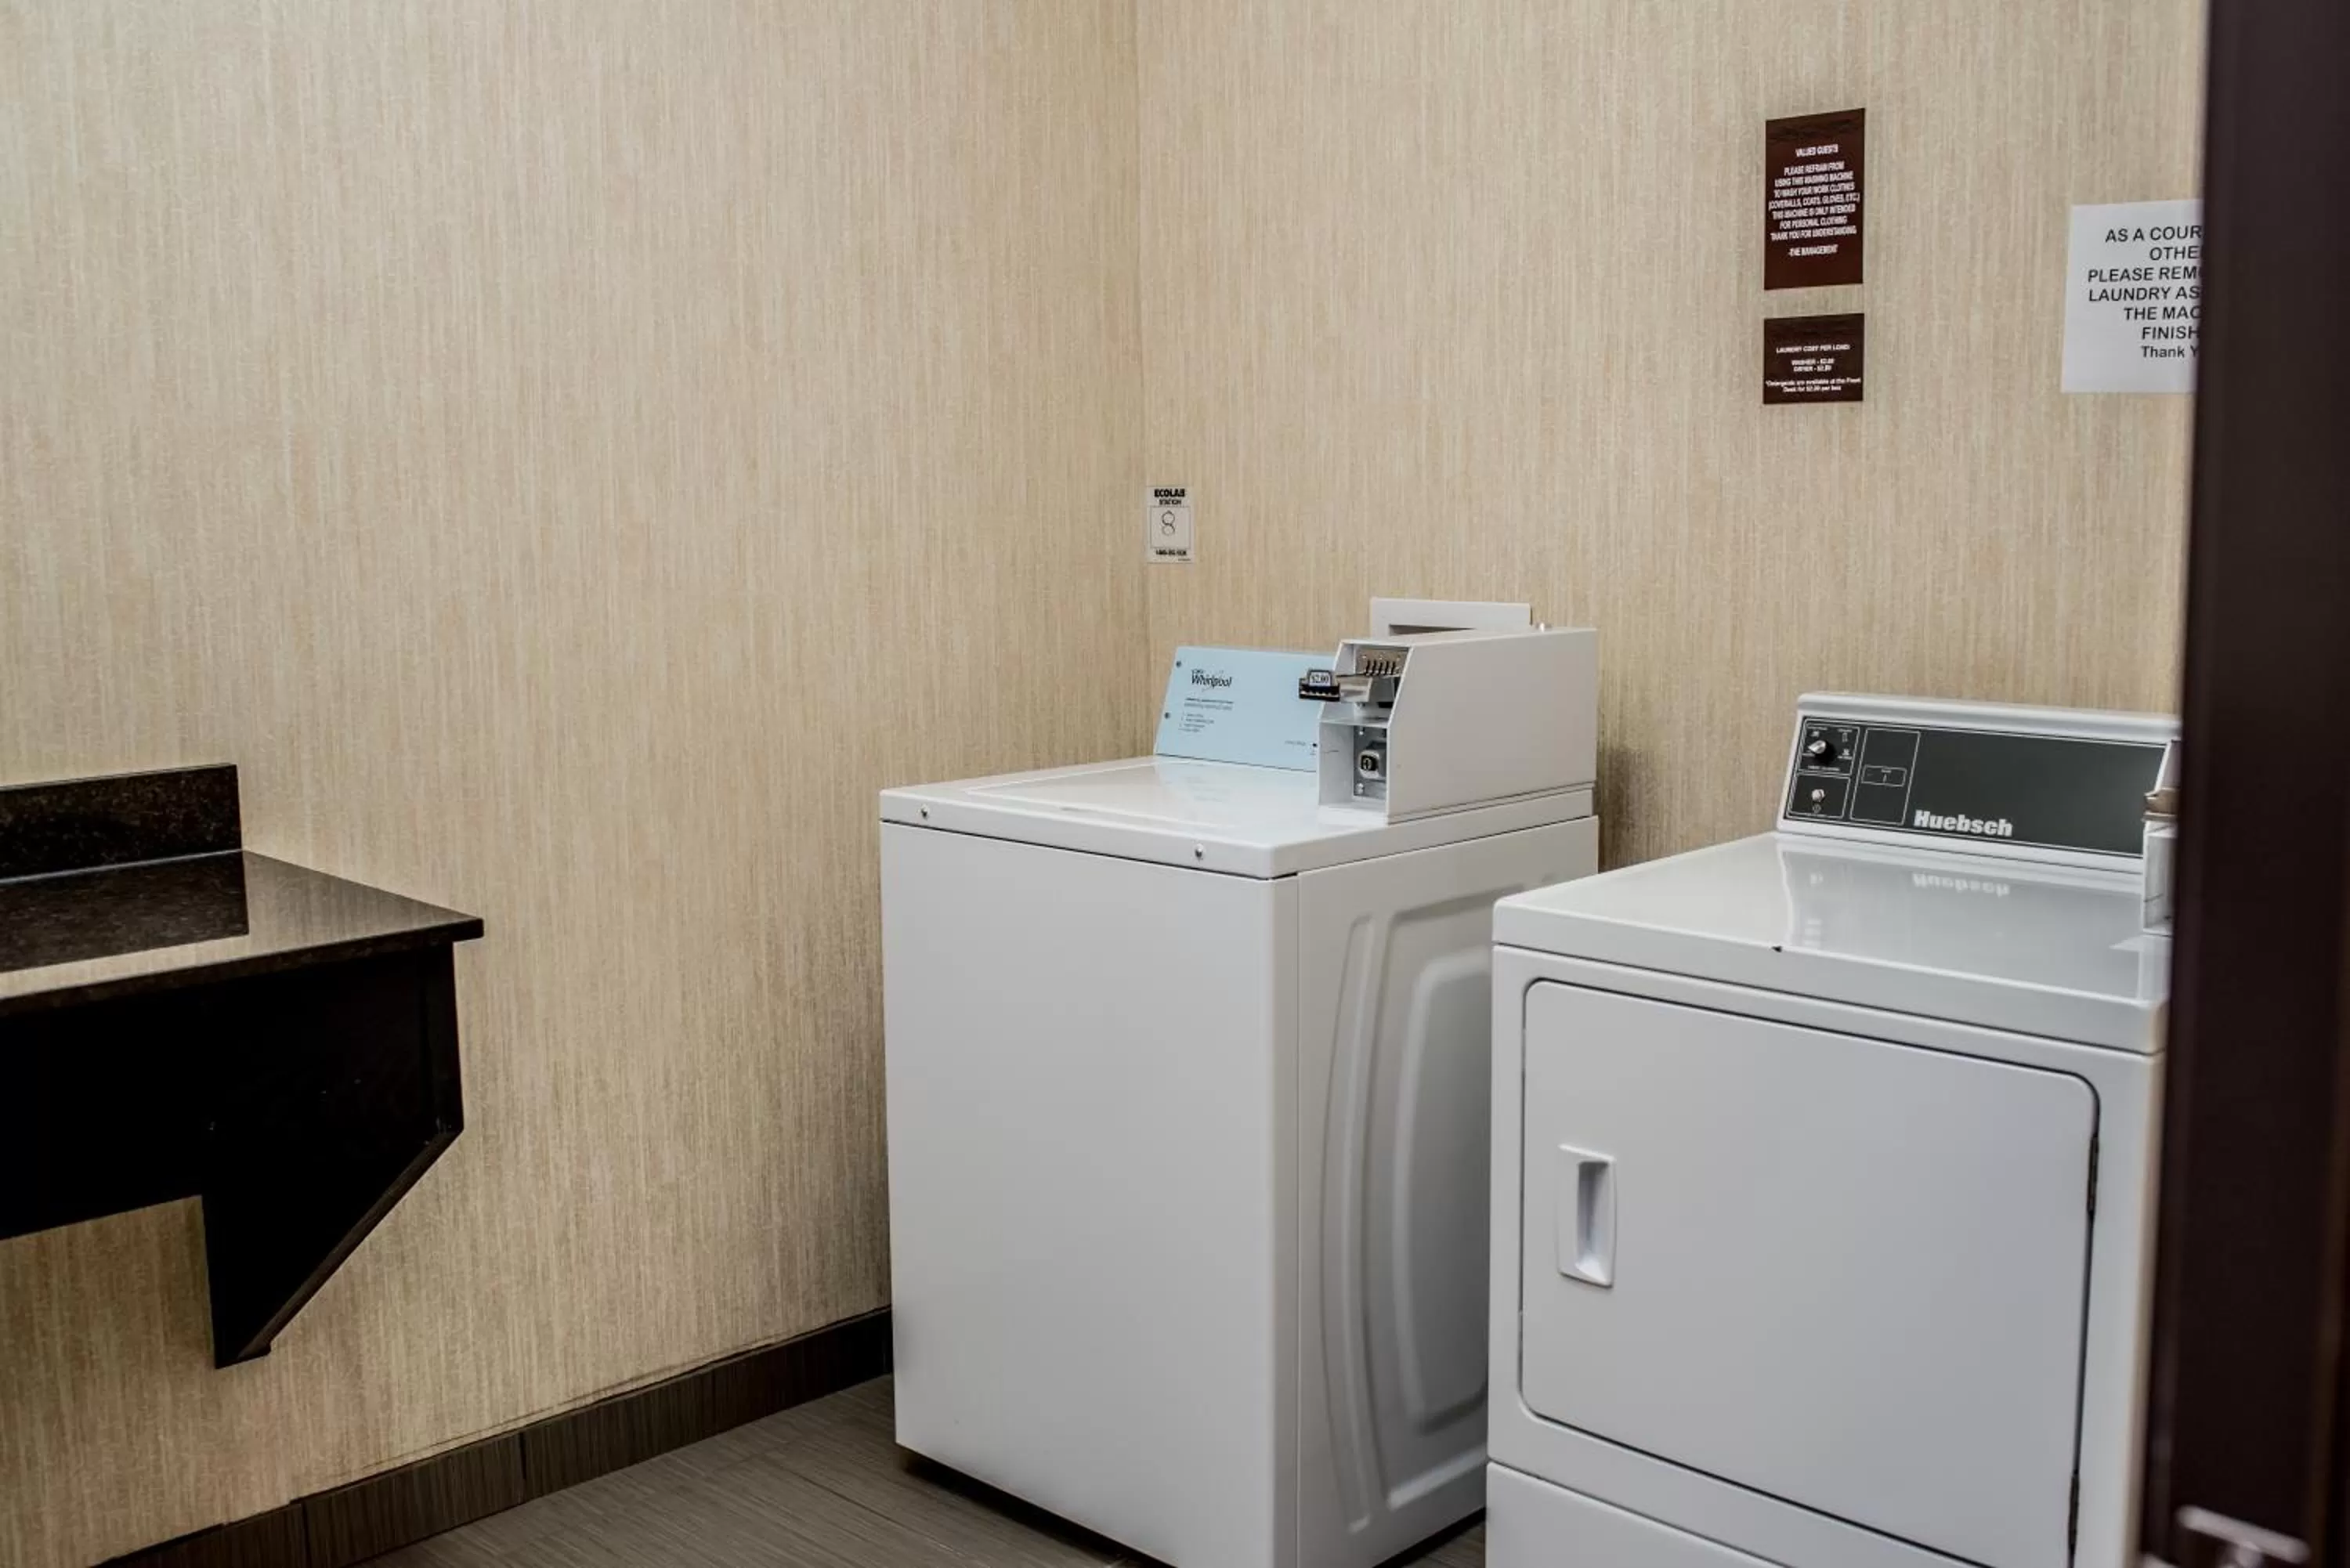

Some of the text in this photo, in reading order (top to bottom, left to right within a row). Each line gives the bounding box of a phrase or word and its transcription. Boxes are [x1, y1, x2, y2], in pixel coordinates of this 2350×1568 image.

[1784, 161, 1845, 175] PLEASE REFRAIN FROM
[1774, 179, 1791, 187] USING
[1804, 175, 1829, 184] WASHING
[1829, 172, 1854, 181] MACHINE
[1798, 187, 1813, 196] YOUR
[1813, 185, 1829, 193] WORK
[1829, 182, 1855, 192] CLOTHES
[1772, 204, 1856, 219] THIS MACHINE IS ONLY INTENDED
[1779, 221, 1791, 229] FOR
[1791, 219, 1820, 228] PERSONAL
[1770, 232, 1788, 240] THANK
[1788, 231, 1801, 240] YOU
[1801, 230, 1812, 239] FOR
[2105, 225, 2203, 243] AS A COUR
[1801, 244, 1838, 256] MANAGEMENT
[2149, 245, 2200, 261] OTHE
[2088, 267, 2154, 283] PLEASE
[2088, 285, 2202, 302] LAUNDRY AS
[2123, 305, 2202, 321] THE MAC
[2141, 325, 2200, 341] FINISH
[2141, 345, 2186, 359] Thank
[1154, 488, 1186, 497] ECOLAB
[1161, 509, 1176, 537] 8
[1191, 673, 1232, 689] Whirlpool
[1914, 809, 2013, 837] Huebsch
